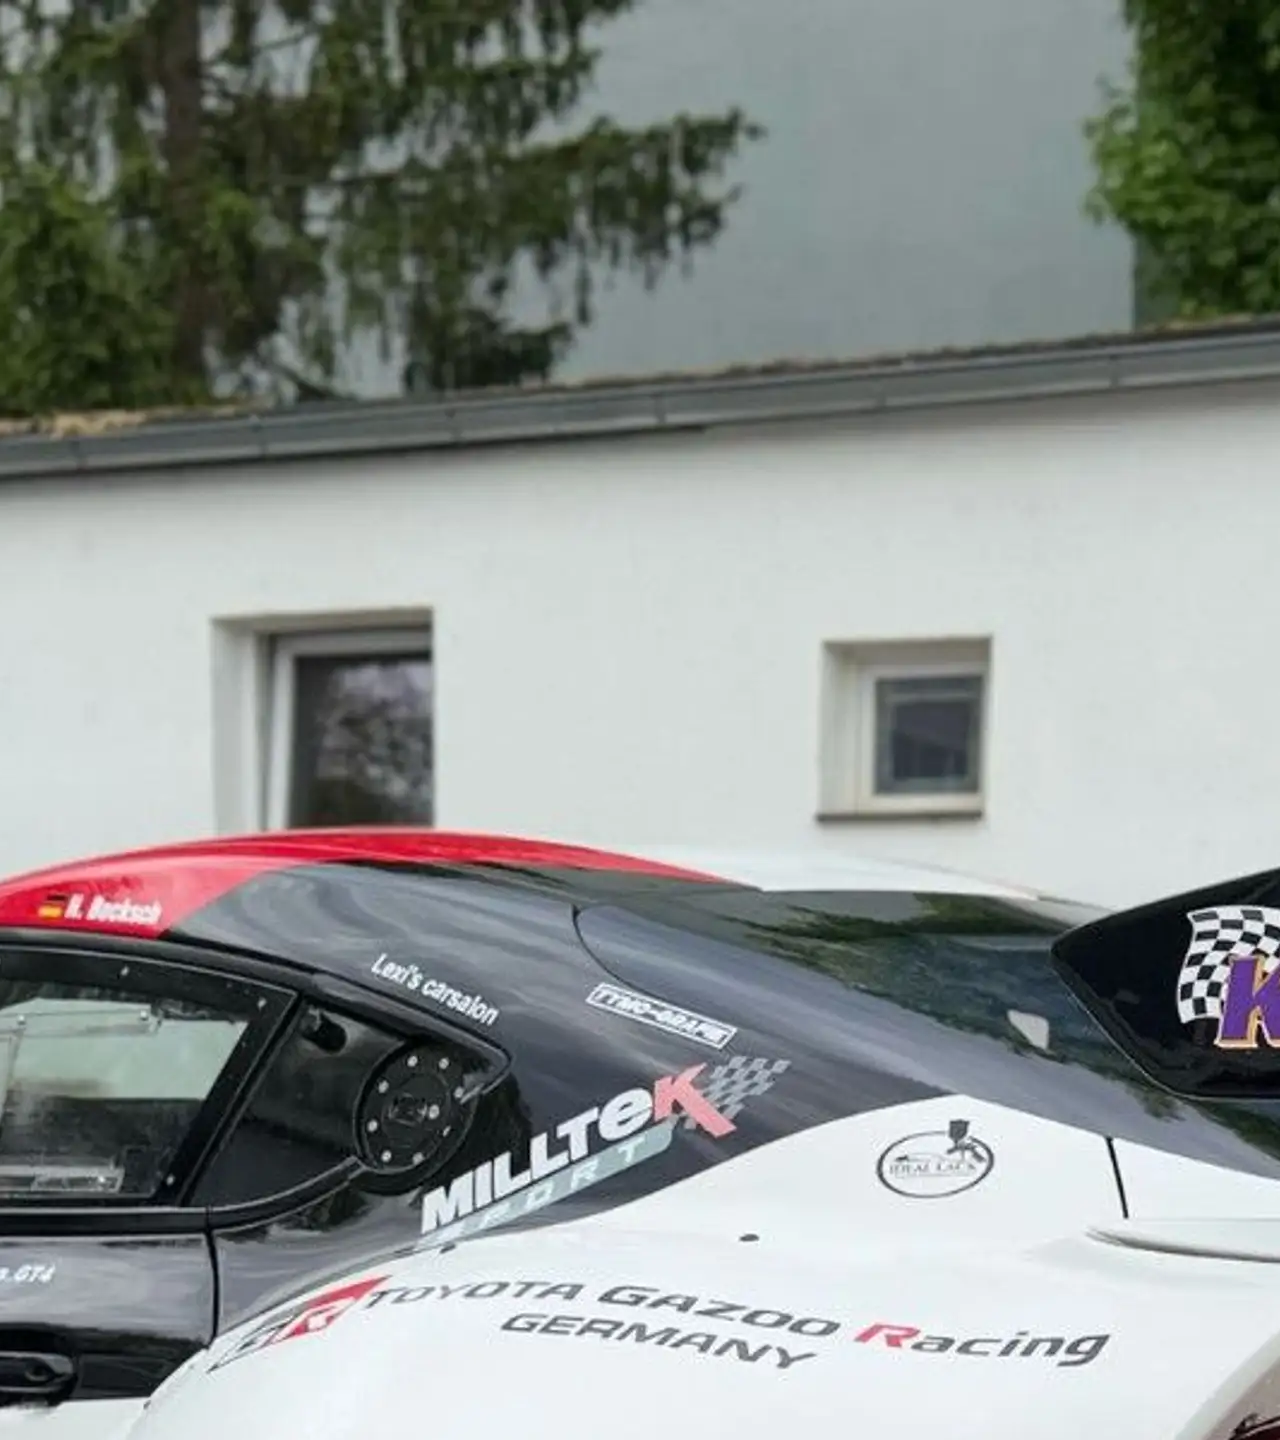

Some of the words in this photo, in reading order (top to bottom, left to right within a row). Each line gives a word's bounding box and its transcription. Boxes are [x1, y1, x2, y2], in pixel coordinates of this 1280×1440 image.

[421, 979, 499, 1026] carsalon
[362, 1281, 586, 1309] TOYOTA
[595, 1285, 841, 1338] GAZOO
[854, 1323, 1111, 1368] Racing
[500, 1312, 818, 1370] GERMANY
